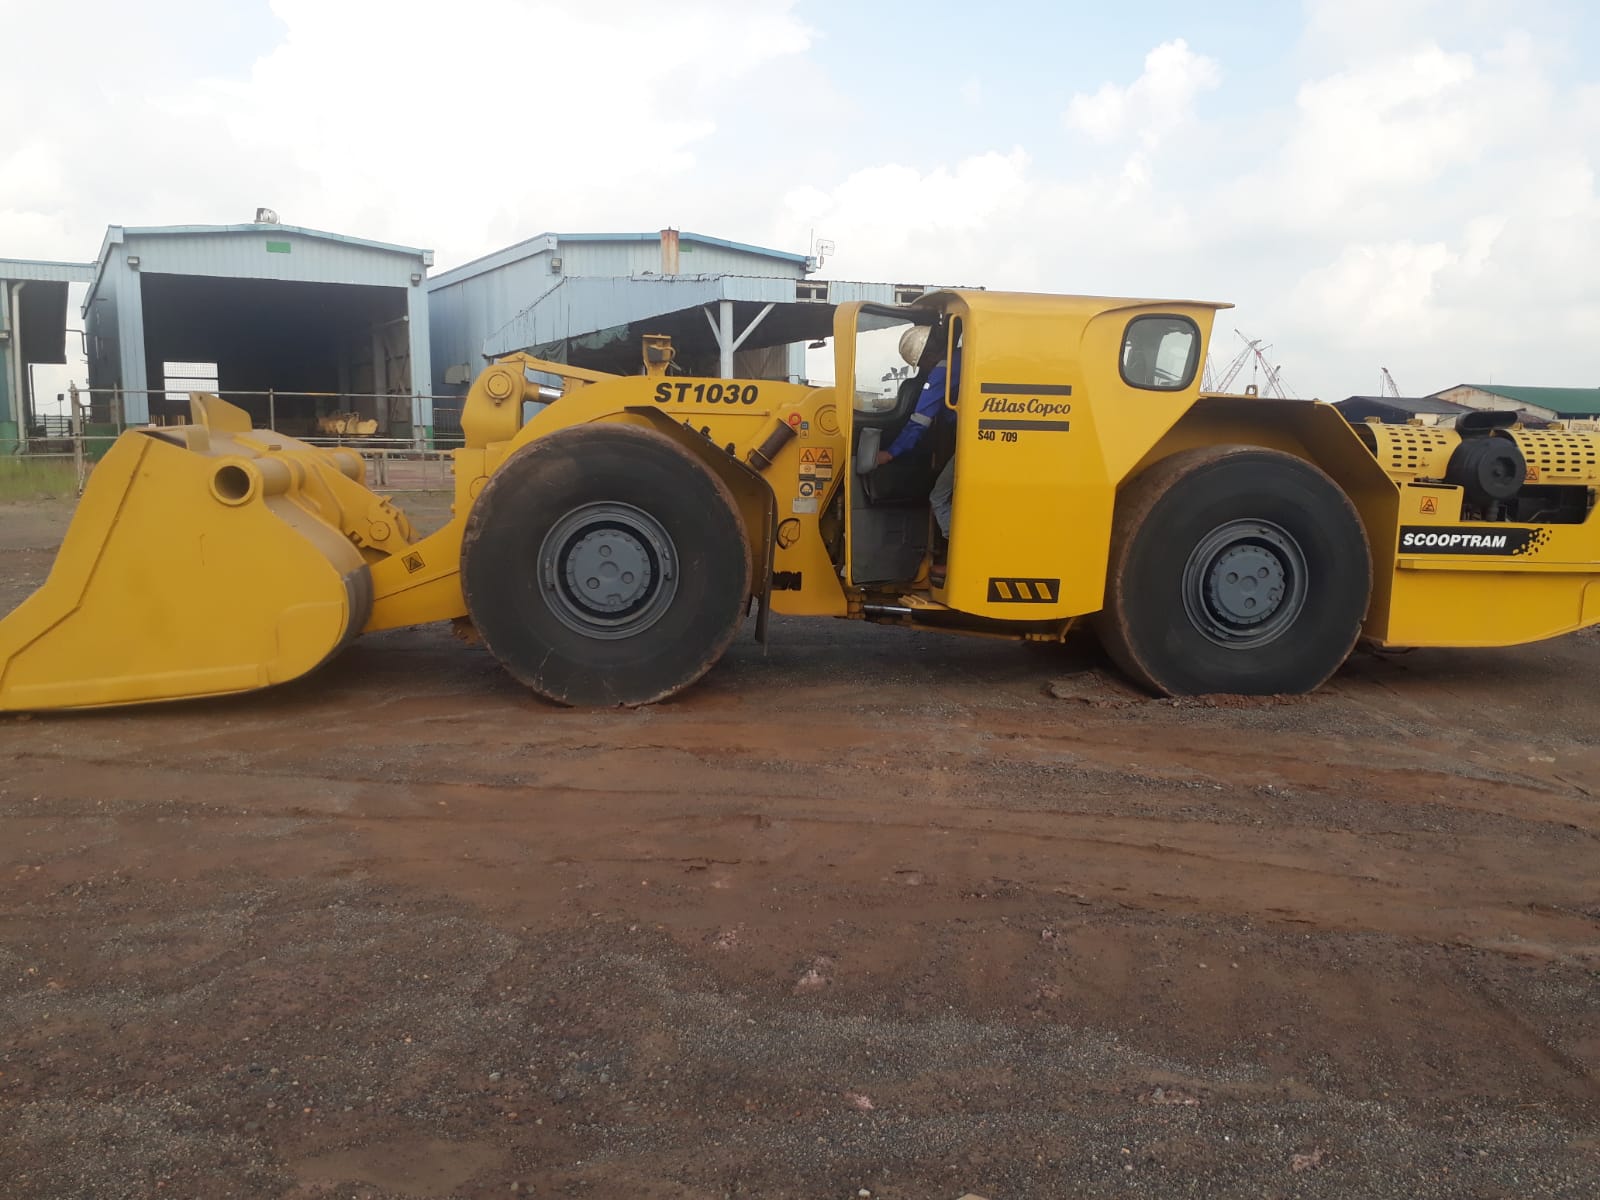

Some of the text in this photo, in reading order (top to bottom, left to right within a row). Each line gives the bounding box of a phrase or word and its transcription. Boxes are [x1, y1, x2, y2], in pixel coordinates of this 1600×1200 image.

[654, 382, 759, 405] ST1030
[980, 397, 1071, 417] Atlas Copco
[977, 430, 1018, 442] S40 709
[1402, 533, 1507, 548] SCOOPTRAM
